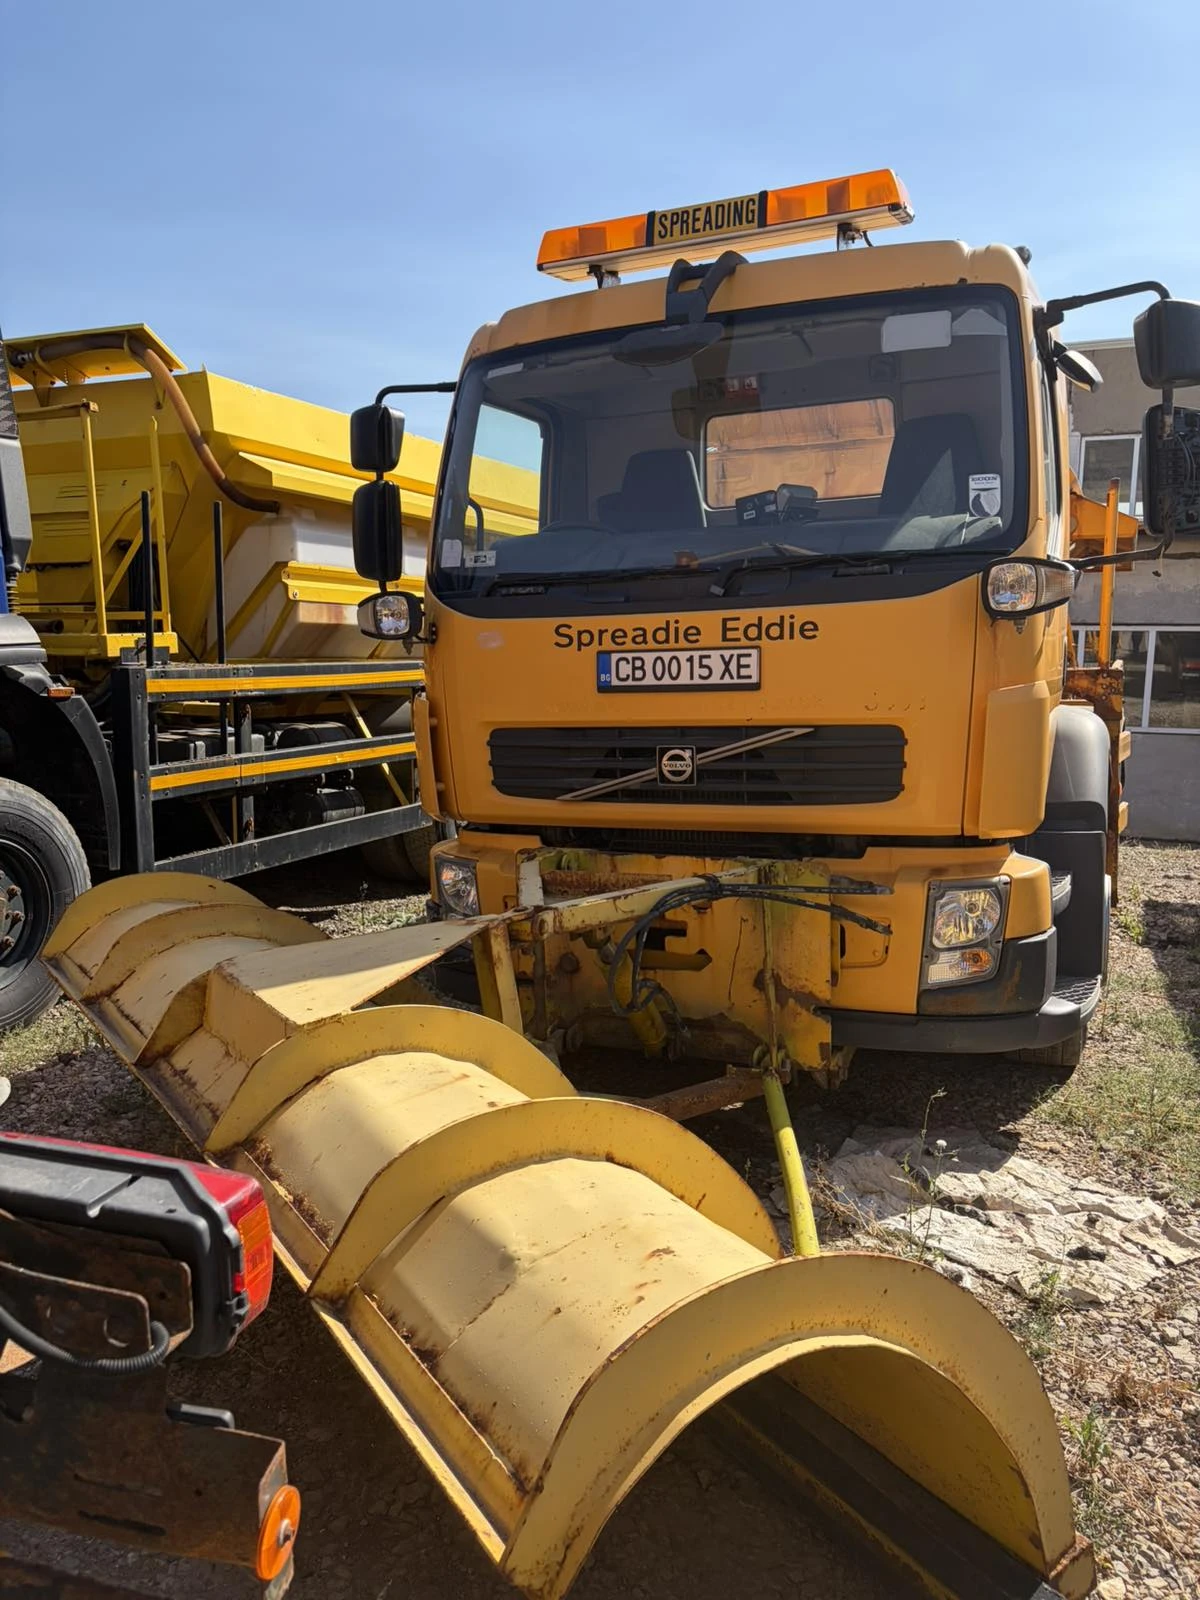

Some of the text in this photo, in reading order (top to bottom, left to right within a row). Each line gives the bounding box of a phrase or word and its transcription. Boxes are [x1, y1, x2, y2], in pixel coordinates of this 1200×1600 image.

[658, 198, 756, 239] SPREADING
[554, 614, 819, 652] Spreadie Eddie
[600, 674, 611, 682] BG
